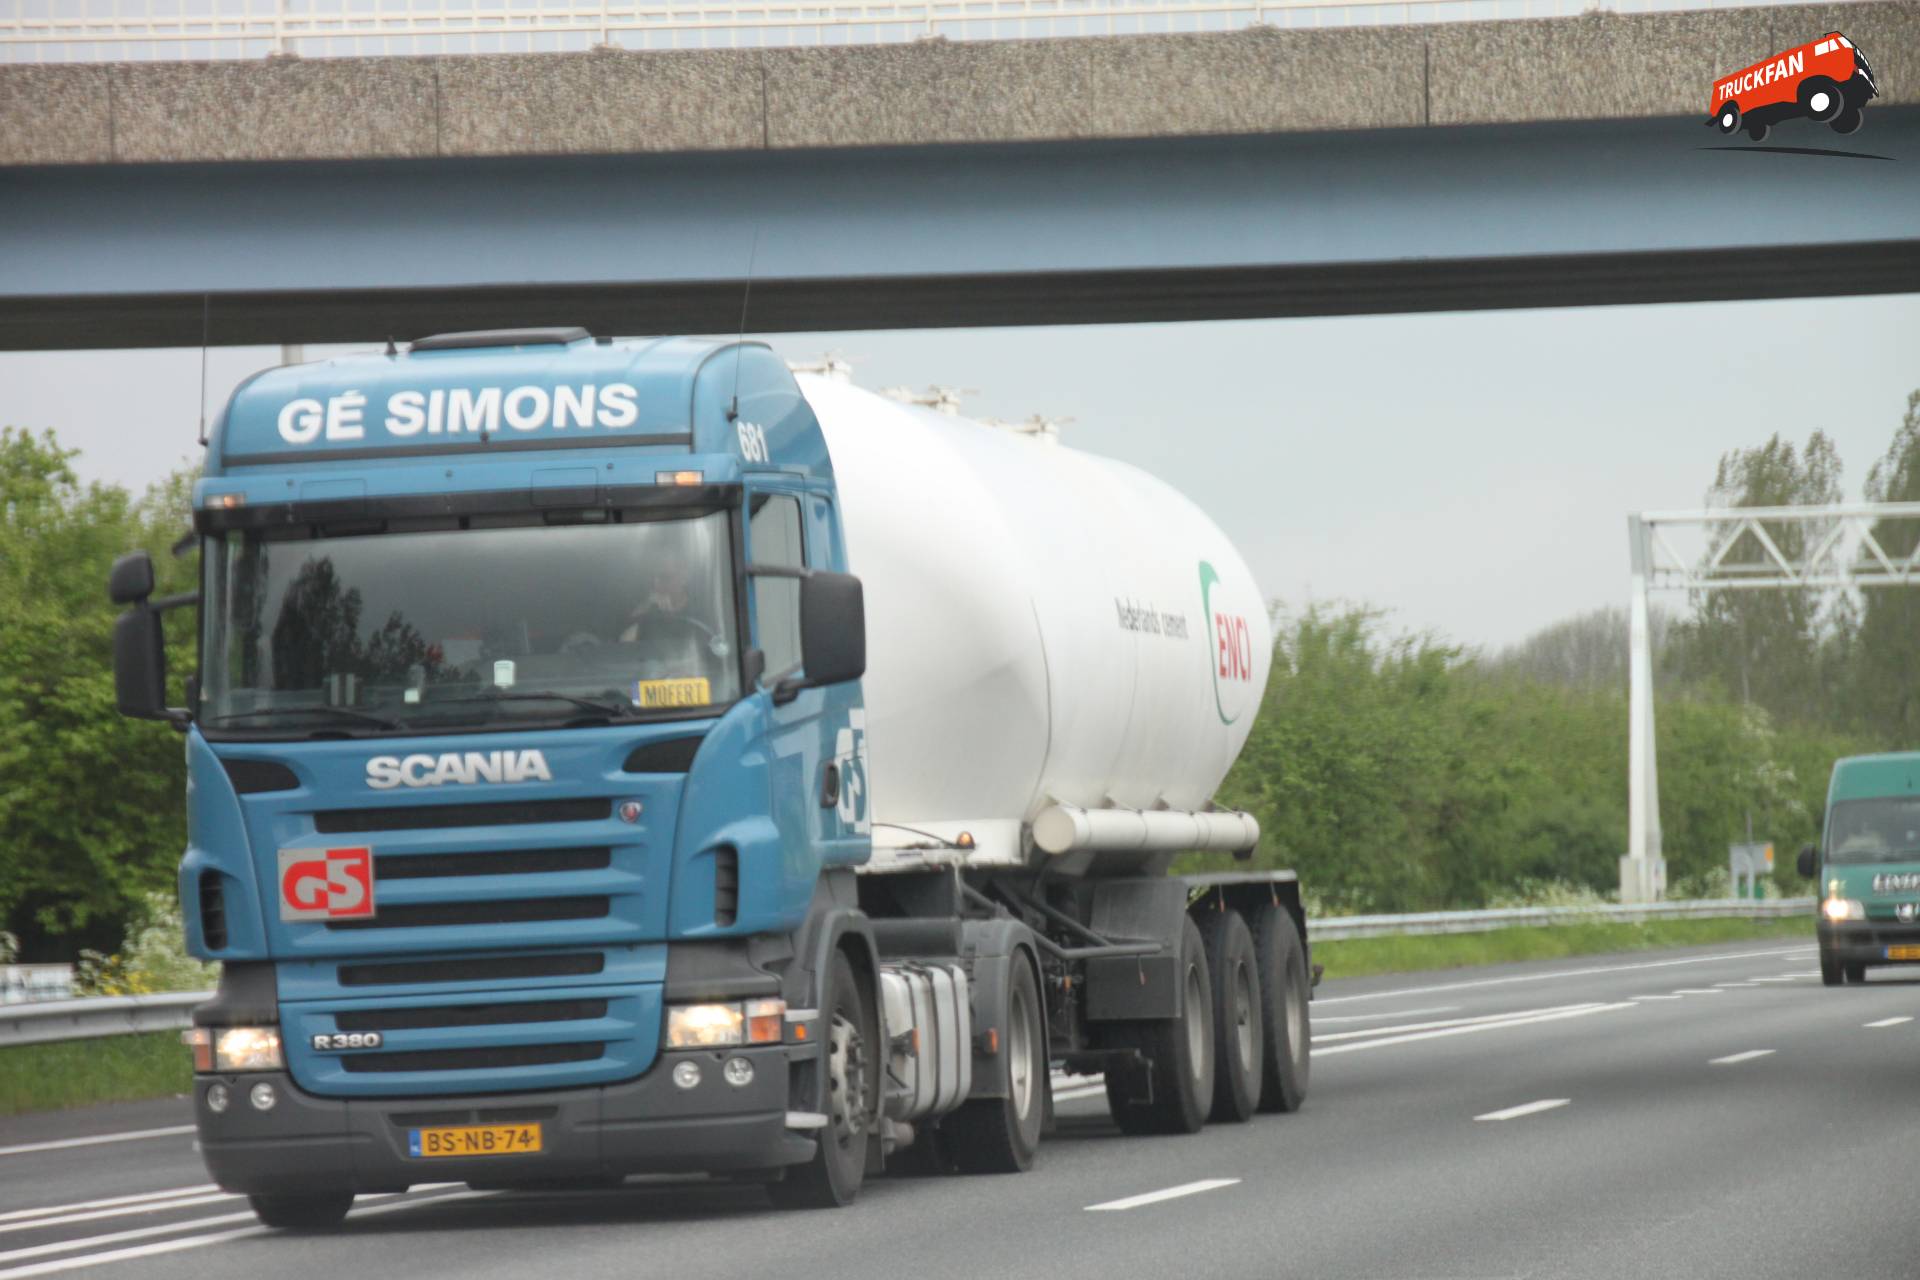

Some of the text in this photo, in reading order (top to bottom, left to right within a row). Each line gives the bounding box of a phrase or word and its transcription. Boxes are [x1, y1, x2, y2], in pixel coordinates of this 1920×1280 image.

[277, 382, 639, 444] GÉ SIMONS
[737, 421, 770, 463] 681
[1215, 612, 1252, 683] ENCI
[365, 749, 552, 789] SCANIA
[427, 1129, 535, 1153] BS-NB-74
